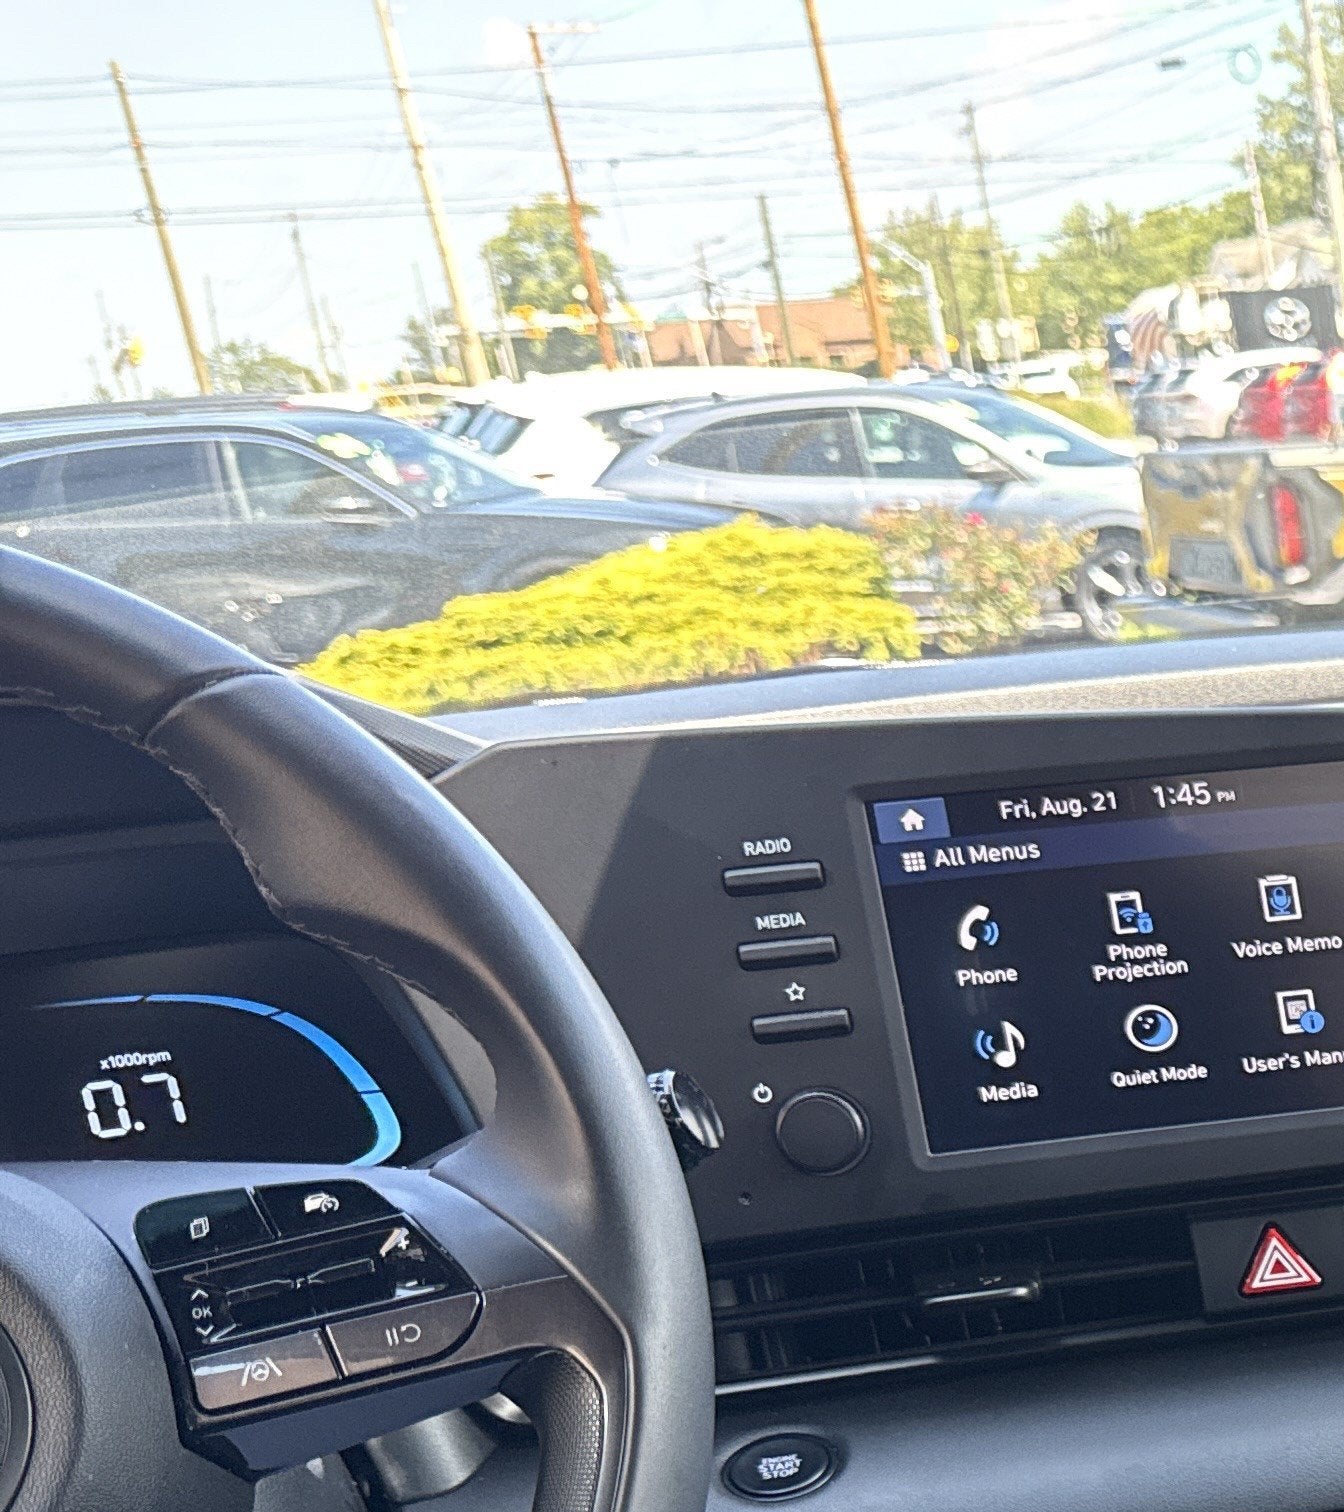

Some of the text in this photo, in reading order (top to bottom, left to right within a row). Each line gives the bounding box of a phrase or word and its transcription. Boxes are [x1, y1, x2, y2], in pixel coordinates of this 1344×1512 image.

[999, 790, 1117, 820] Fri, Aug. 21
[1152, 781, 1236, 809] 1:45 PM
[743, 837, 792, 857] RADIO
[933, 842, 1041, 868] All Menus
[755, 911, 807, 931] MEDIA
[1107, 943, 1168, 961] Phone
[1230, 935, 1344, 959] Voice Memo
[955, 967, 1019, 988] Phone
[1092, 959, 1189, 982] Projection
[99, 1050, 173, 1071] x1000rpm
[1242, 1053, 1302, 1074] User's
[1110, 1063, 1209, 1088] Quiet Mode
[977, 1081, 1040, 1103] Media
[81, 1072, 187, 1139] 0.7
[191, 1304, 213, 1320] OK
